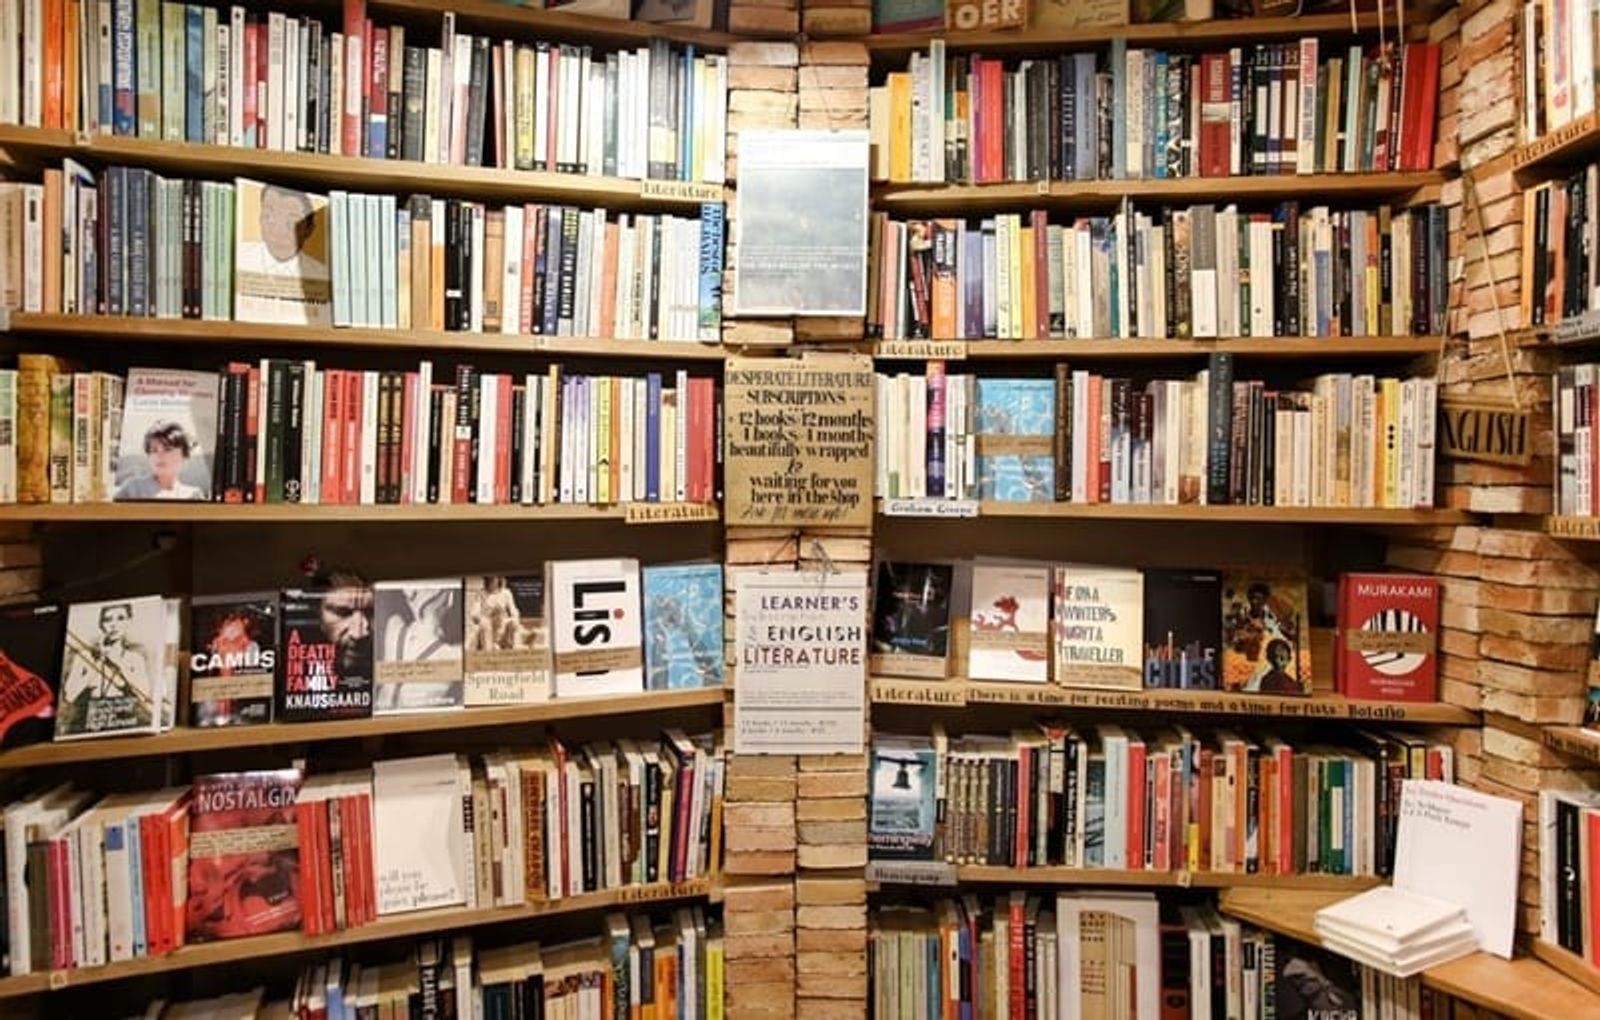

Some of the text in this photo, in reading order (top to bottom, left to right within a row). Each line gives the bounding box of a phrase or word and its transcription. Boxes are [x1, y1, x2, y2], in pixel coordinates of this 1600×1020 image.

[1512, 121, 1590, 168] Literature
[643, 182, 719, 199] Literature
[877, 341, 962, 357] Literature
[818, 409, 875, 428] months
[1441, 408, 1526, 456] NGLISH
[730, 441, 870, 463] beautifully wrapped
[749, 472, 807, 491] waiting
[810, 472, 830, 488] for
[751, 488, 784, 504] here
[806, 489, 829, 504] the
[829, 489, 860, 509] shop
[1357, 584, 1433, 597] MURAKAMI
[761, 595, 859, 611] LEARNER'S
[289, 629, 301, 643] A
[768, 625, 861, 641] ENGLISH
[288, 643, 336, 660] DEATH
[744, 647, 860, 665] LITERATURE
[191, 649, 276, 673] CAMUS
[288, 659, 336, 676] IN THE
[287, 675, 338, 692] FAMILY
[285, 691, 371, 710] KNAUSGAARD
[875, 687, 959, 702] Literature
[197, 787, 296, 813] NOSTALGIA
[622, 881, 708, 901] Literature
